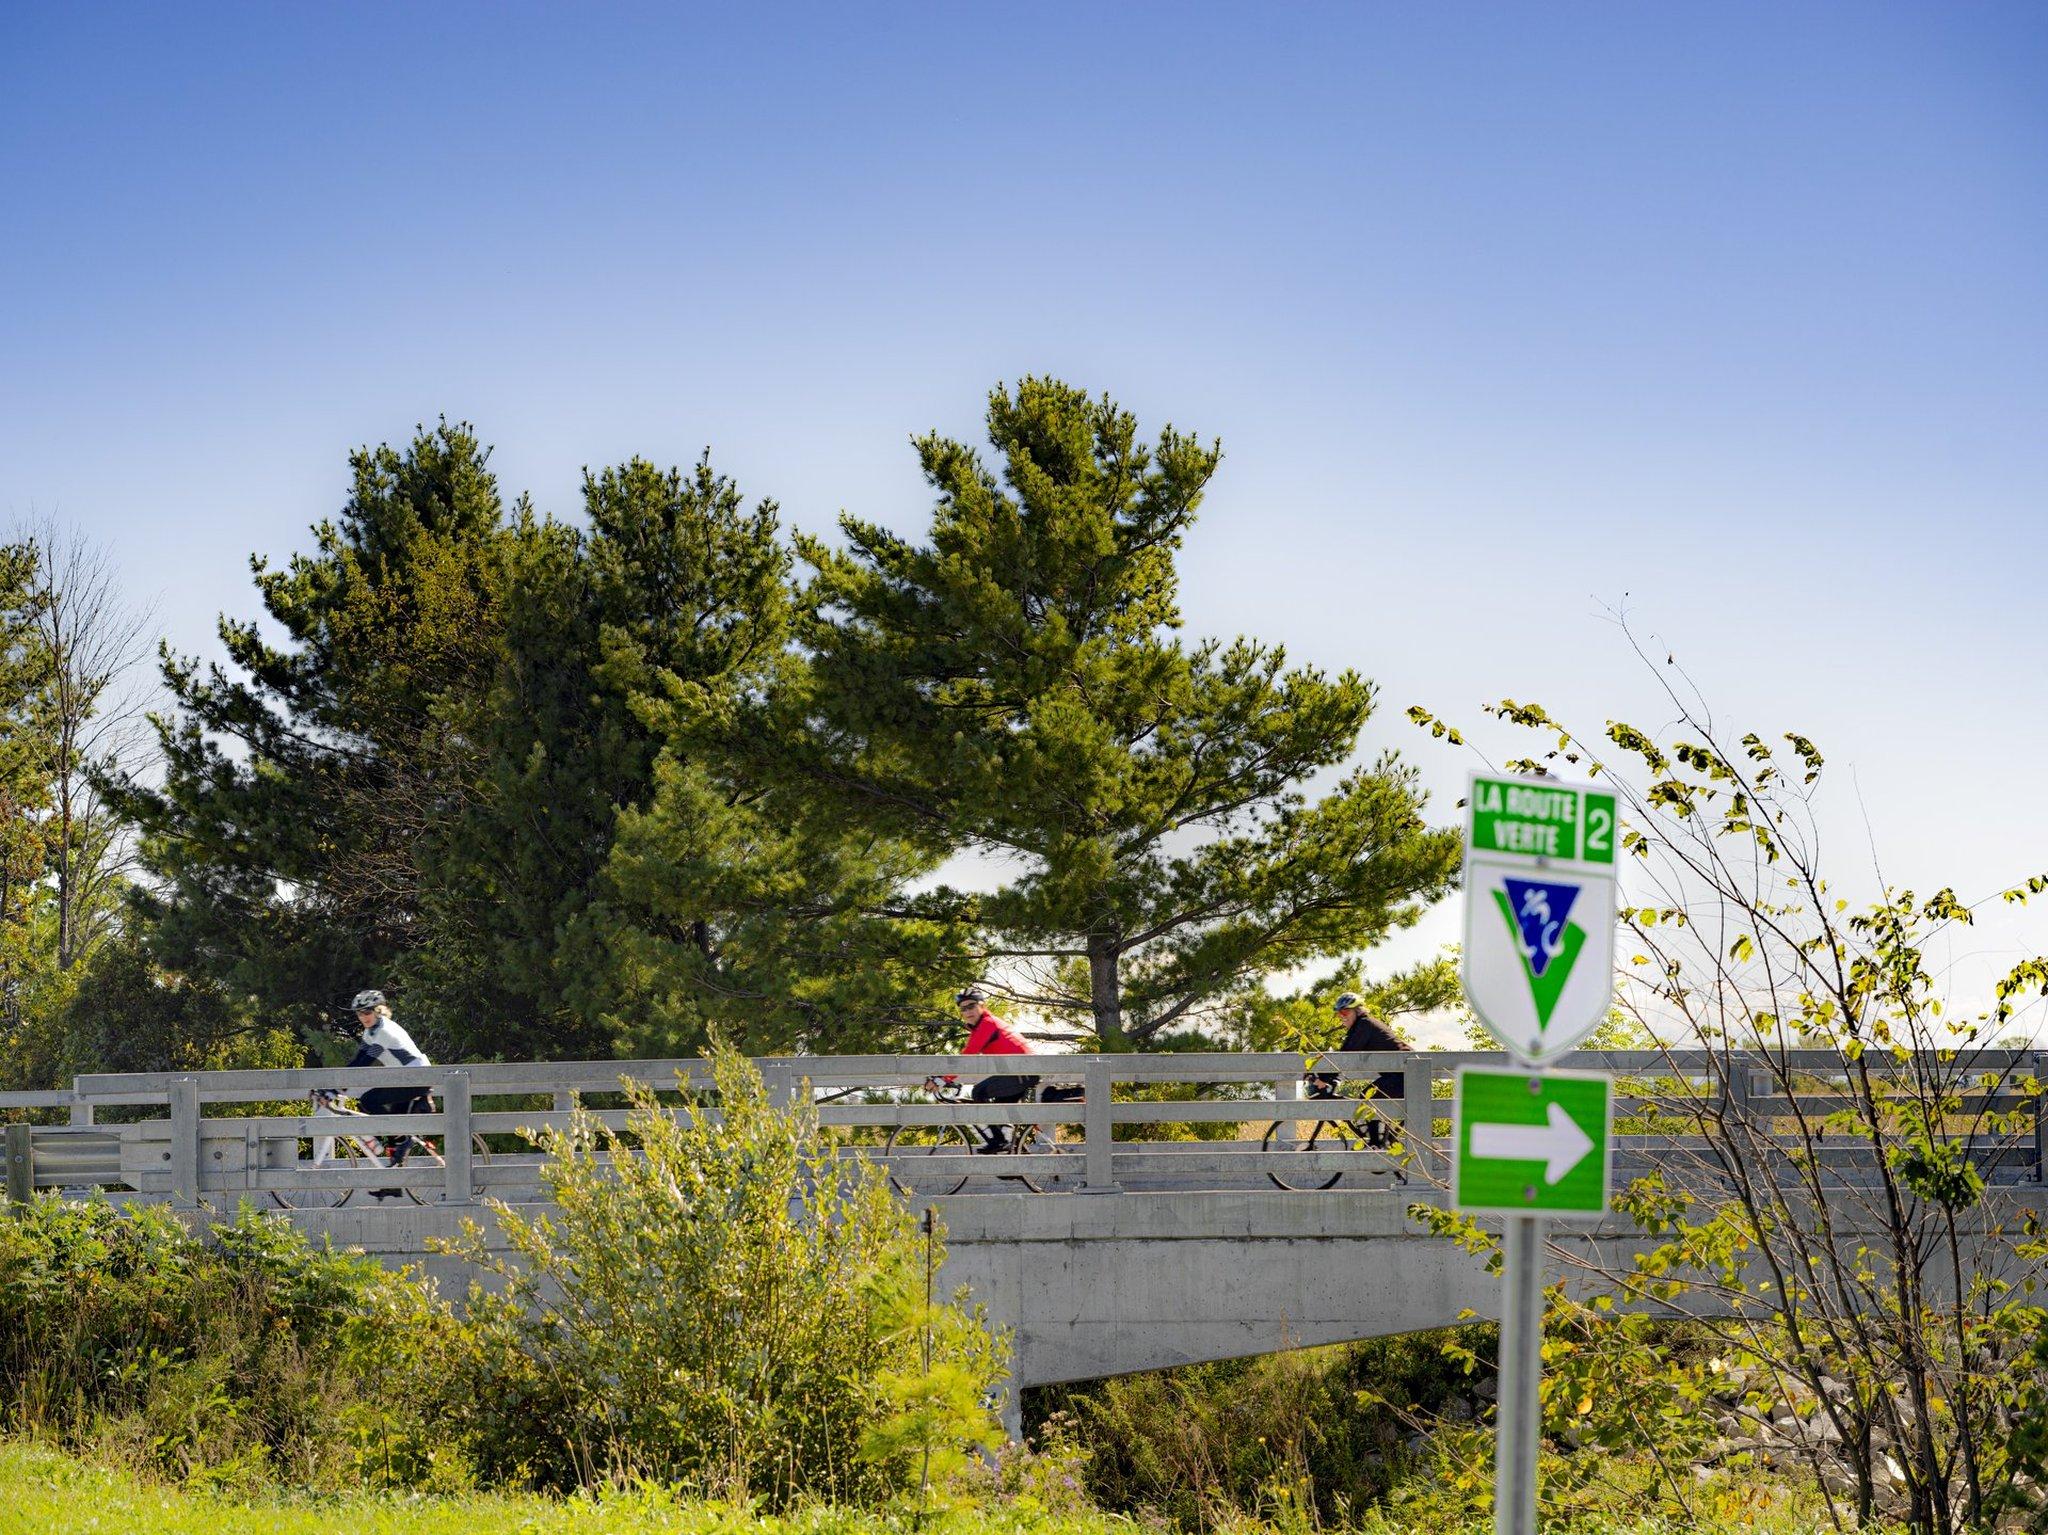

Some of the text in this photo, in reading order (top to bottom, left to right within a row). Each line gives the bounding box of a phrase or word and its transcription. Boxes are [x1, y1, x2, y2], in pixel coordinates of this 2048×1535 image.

[1476, 783, 1576, 823] LA ROUTE
[1493, 820, 1560, 854] VERTE
[1587, 808, 1611, 850] 2
